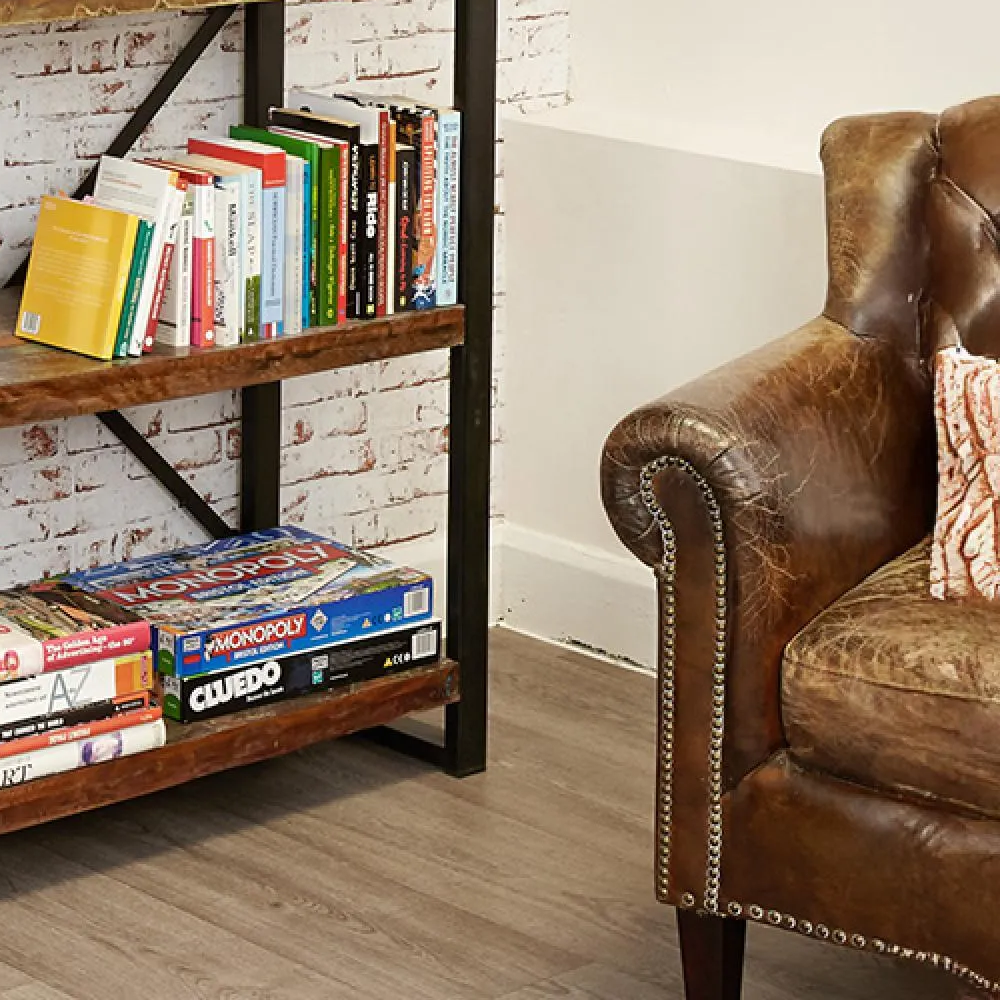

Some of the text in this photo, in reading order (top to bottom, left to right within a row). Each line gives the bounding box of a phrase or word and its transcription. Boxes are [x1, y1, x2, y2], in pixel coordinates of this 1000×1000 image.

[113, 541, 331, 605] MONOPOLY
[212, 616, 305, 652] MONOPOLY
[188, 660, 283, 712] CLUEDO
